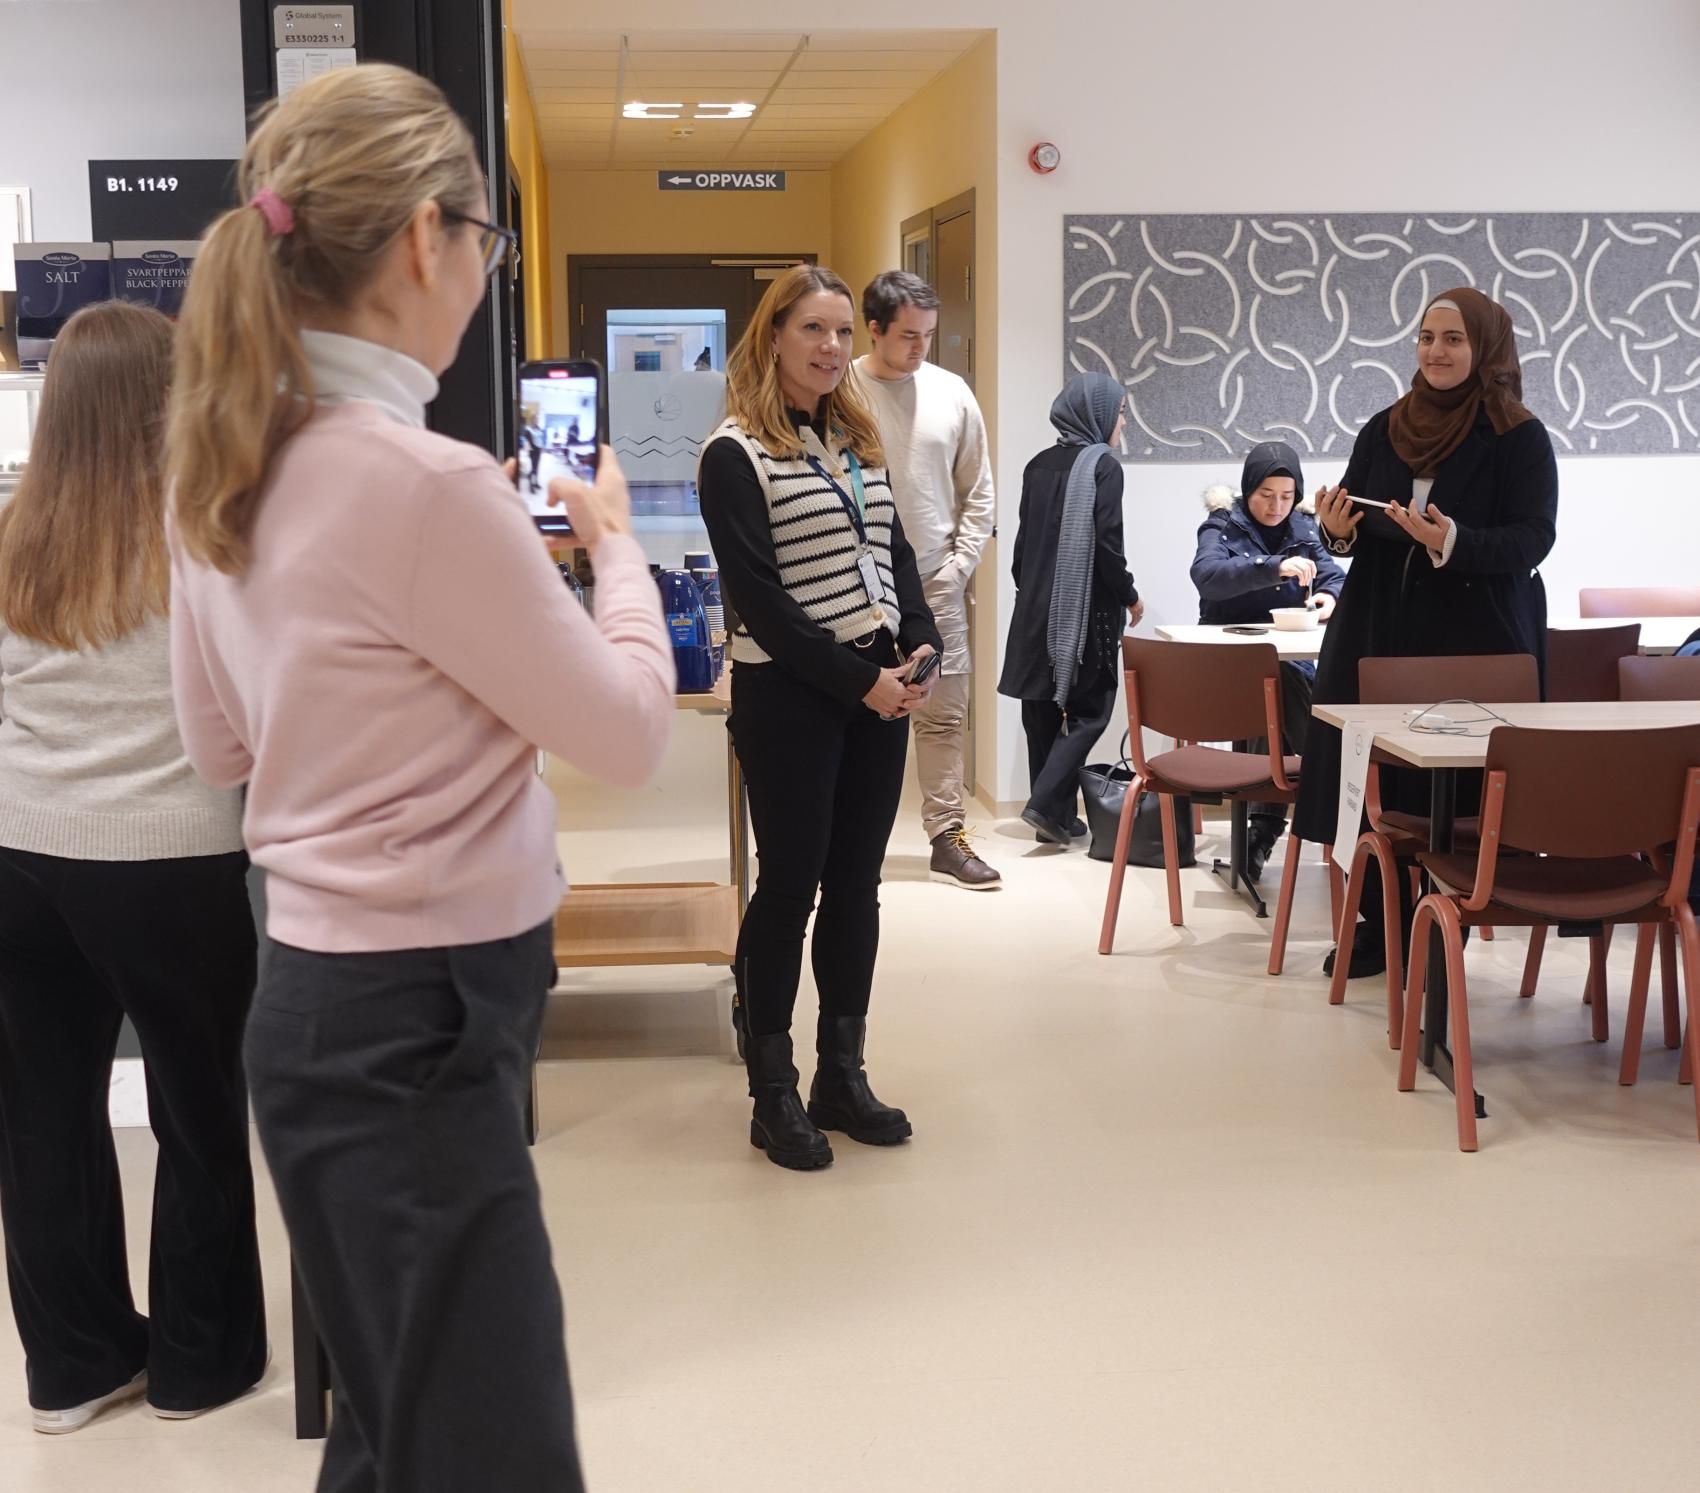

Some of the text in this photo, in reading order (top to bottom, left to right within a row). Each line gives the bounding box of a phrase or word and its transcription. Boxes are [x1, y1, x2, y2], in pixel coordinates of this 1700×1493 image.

[318, 12, 343, 20] System
[107, 177, 179, 192] B1. 1149
[695, 174, 777, 188] OPPVASK
[45, 271, 80, 283] SALT
[126, 279, 158, 288] BLACK
